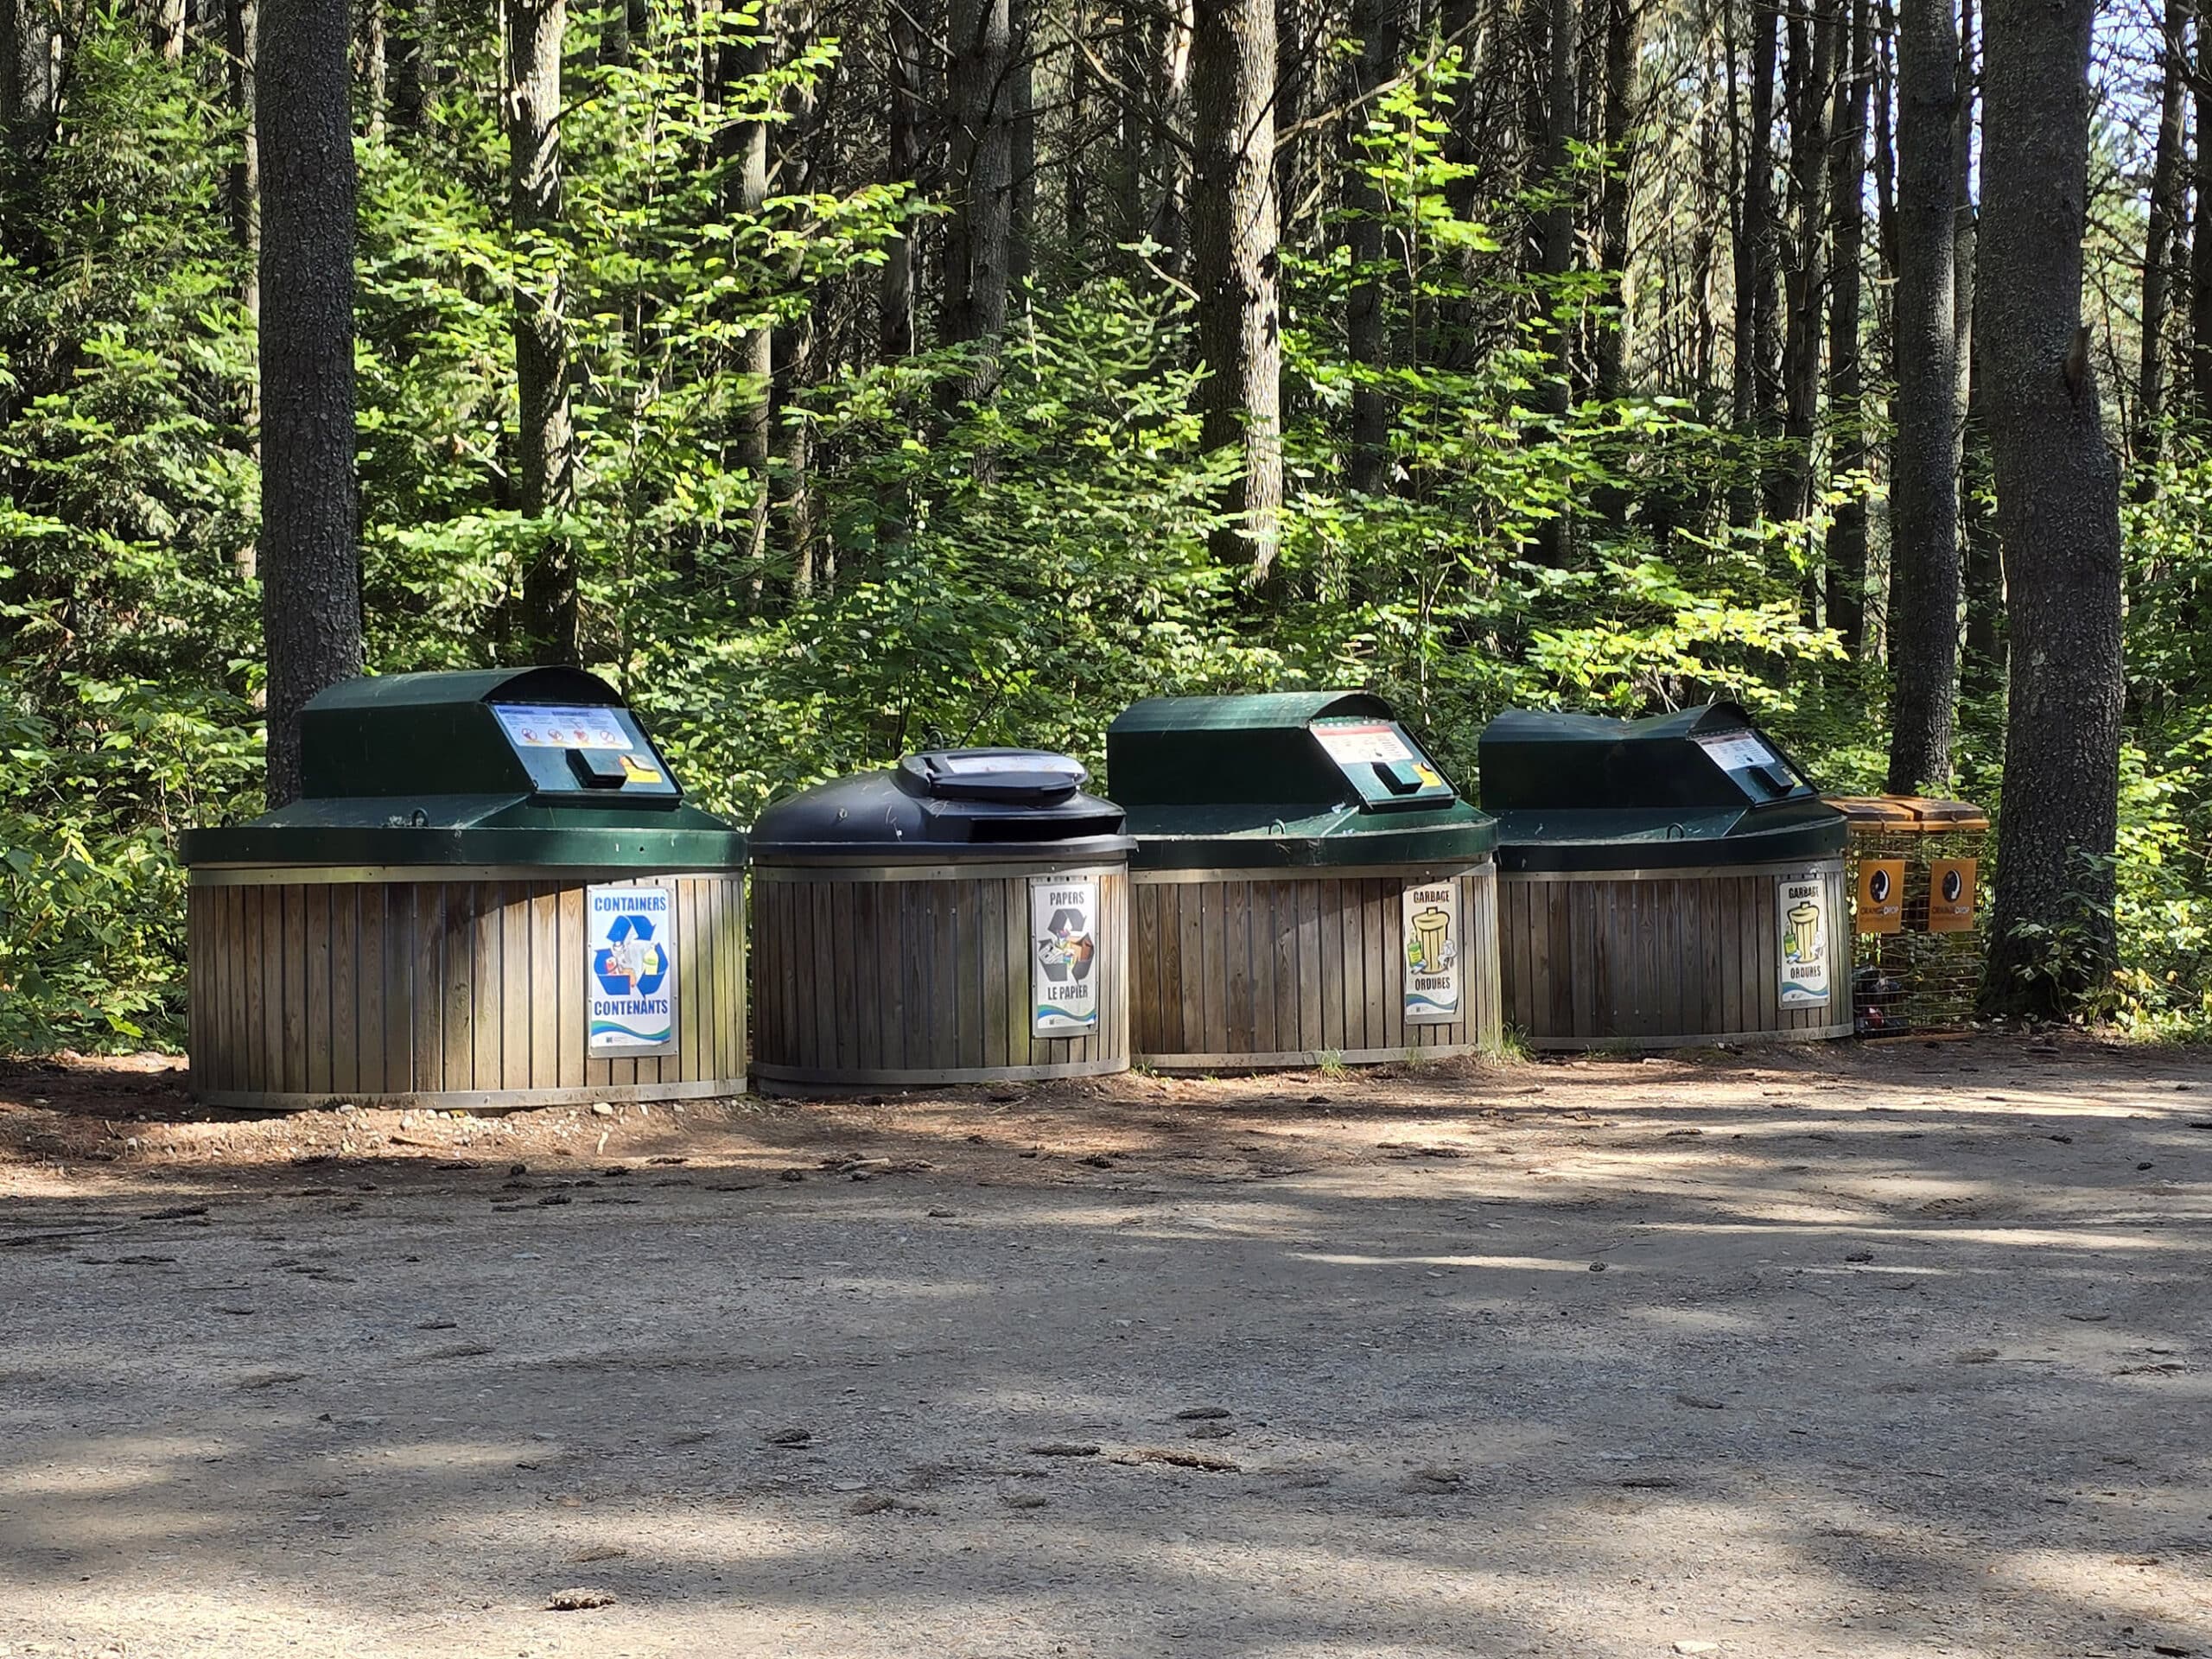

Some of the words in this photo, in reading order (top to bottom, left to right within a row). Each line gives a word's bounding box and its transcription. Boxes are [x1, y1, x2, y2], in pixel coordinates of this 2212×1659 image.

[1050, 892, 1084, 906] PAPERS
[1413, 890, 1450, 904] GARBAGE
[1789, 886, 1819, 899] GARBAGE
[594, 897, 666, 912] CONTAINERS
[1790, 965, 1821, 979] ORDURES
[1414, 976, 1451, 991] ORDURES
[1047, 986, 1058, 1001] LE
[1059, 985, 1089, 1001] PAPIER
[594, 999, 668, 1015] CONTENANTS
